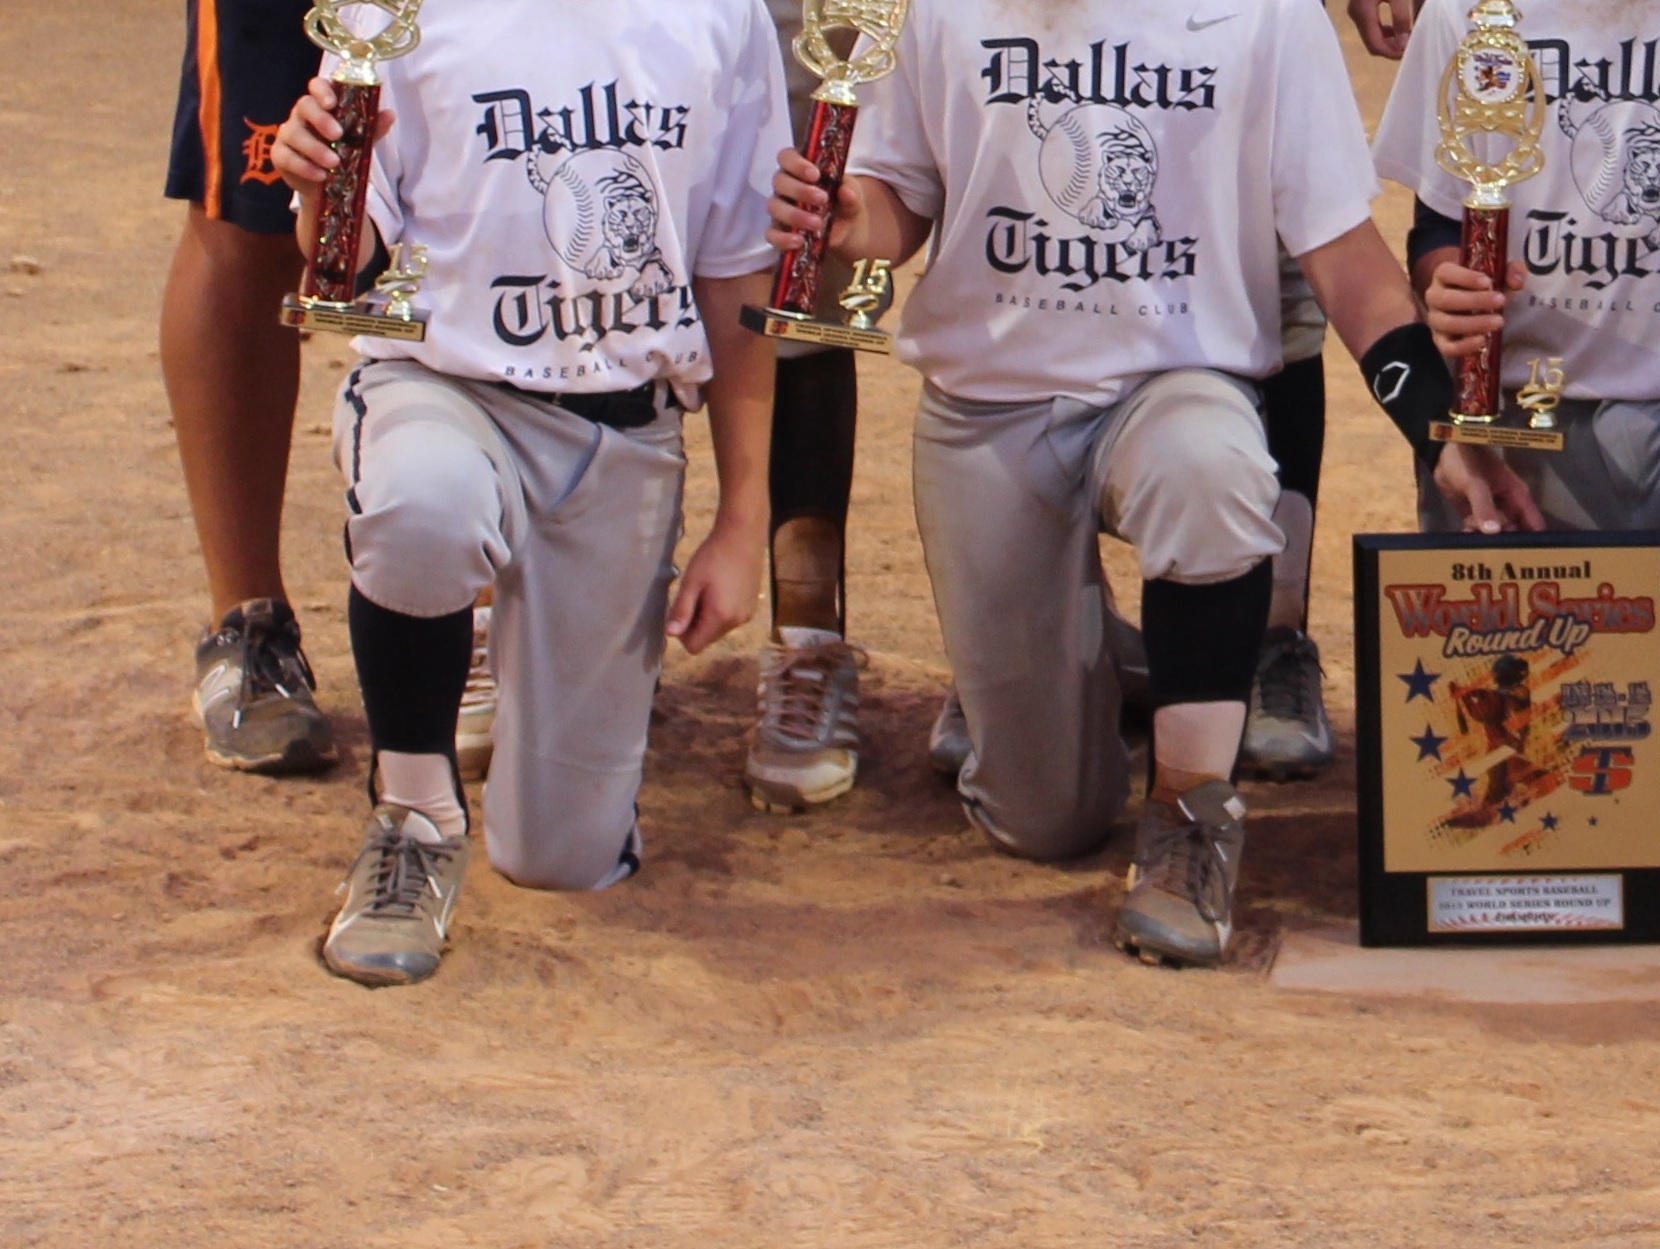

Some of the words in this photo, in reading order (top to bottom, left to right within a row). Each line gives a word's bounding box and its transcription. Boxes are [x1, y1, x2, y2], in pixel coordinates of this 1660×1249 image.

[980, 37, 1217, 112] Dallas
[471, 78, 691, 164] Dallas
[985, 205, 1200, 293] Tigers
[847, 258, 892, 293] 15
[490, 274, 701, 353] Tigers
[996, 293, 1118, 315] BASEBALL
[1138, 302, 1189, 317] CLUB
[505, 358, 628, 379] BASEBALL
[645, 352, 698, 365] CUB
[1524, 358, 1564, 391] 15
[1452, 562, 1492, 581] 8th
[1500, 560, 1592, 581] Annual
[1384, 582, 1523, 638] World
[1528, 581, 1655, 634] Series
[1443, 618, 1545, 659] Round
[1546, 613, 1594, 656] Up
[1466, 900, 1507, 909] WORLD
[1510, 899, 1551, 909] SERIES
[1554, 898, 1593, 908] ROUND
[1596, 897, 1611, 907] UP
[1495, 886, 1539, 896] SPORTS
[1543, 885, 1599, 895] BASEBALL
